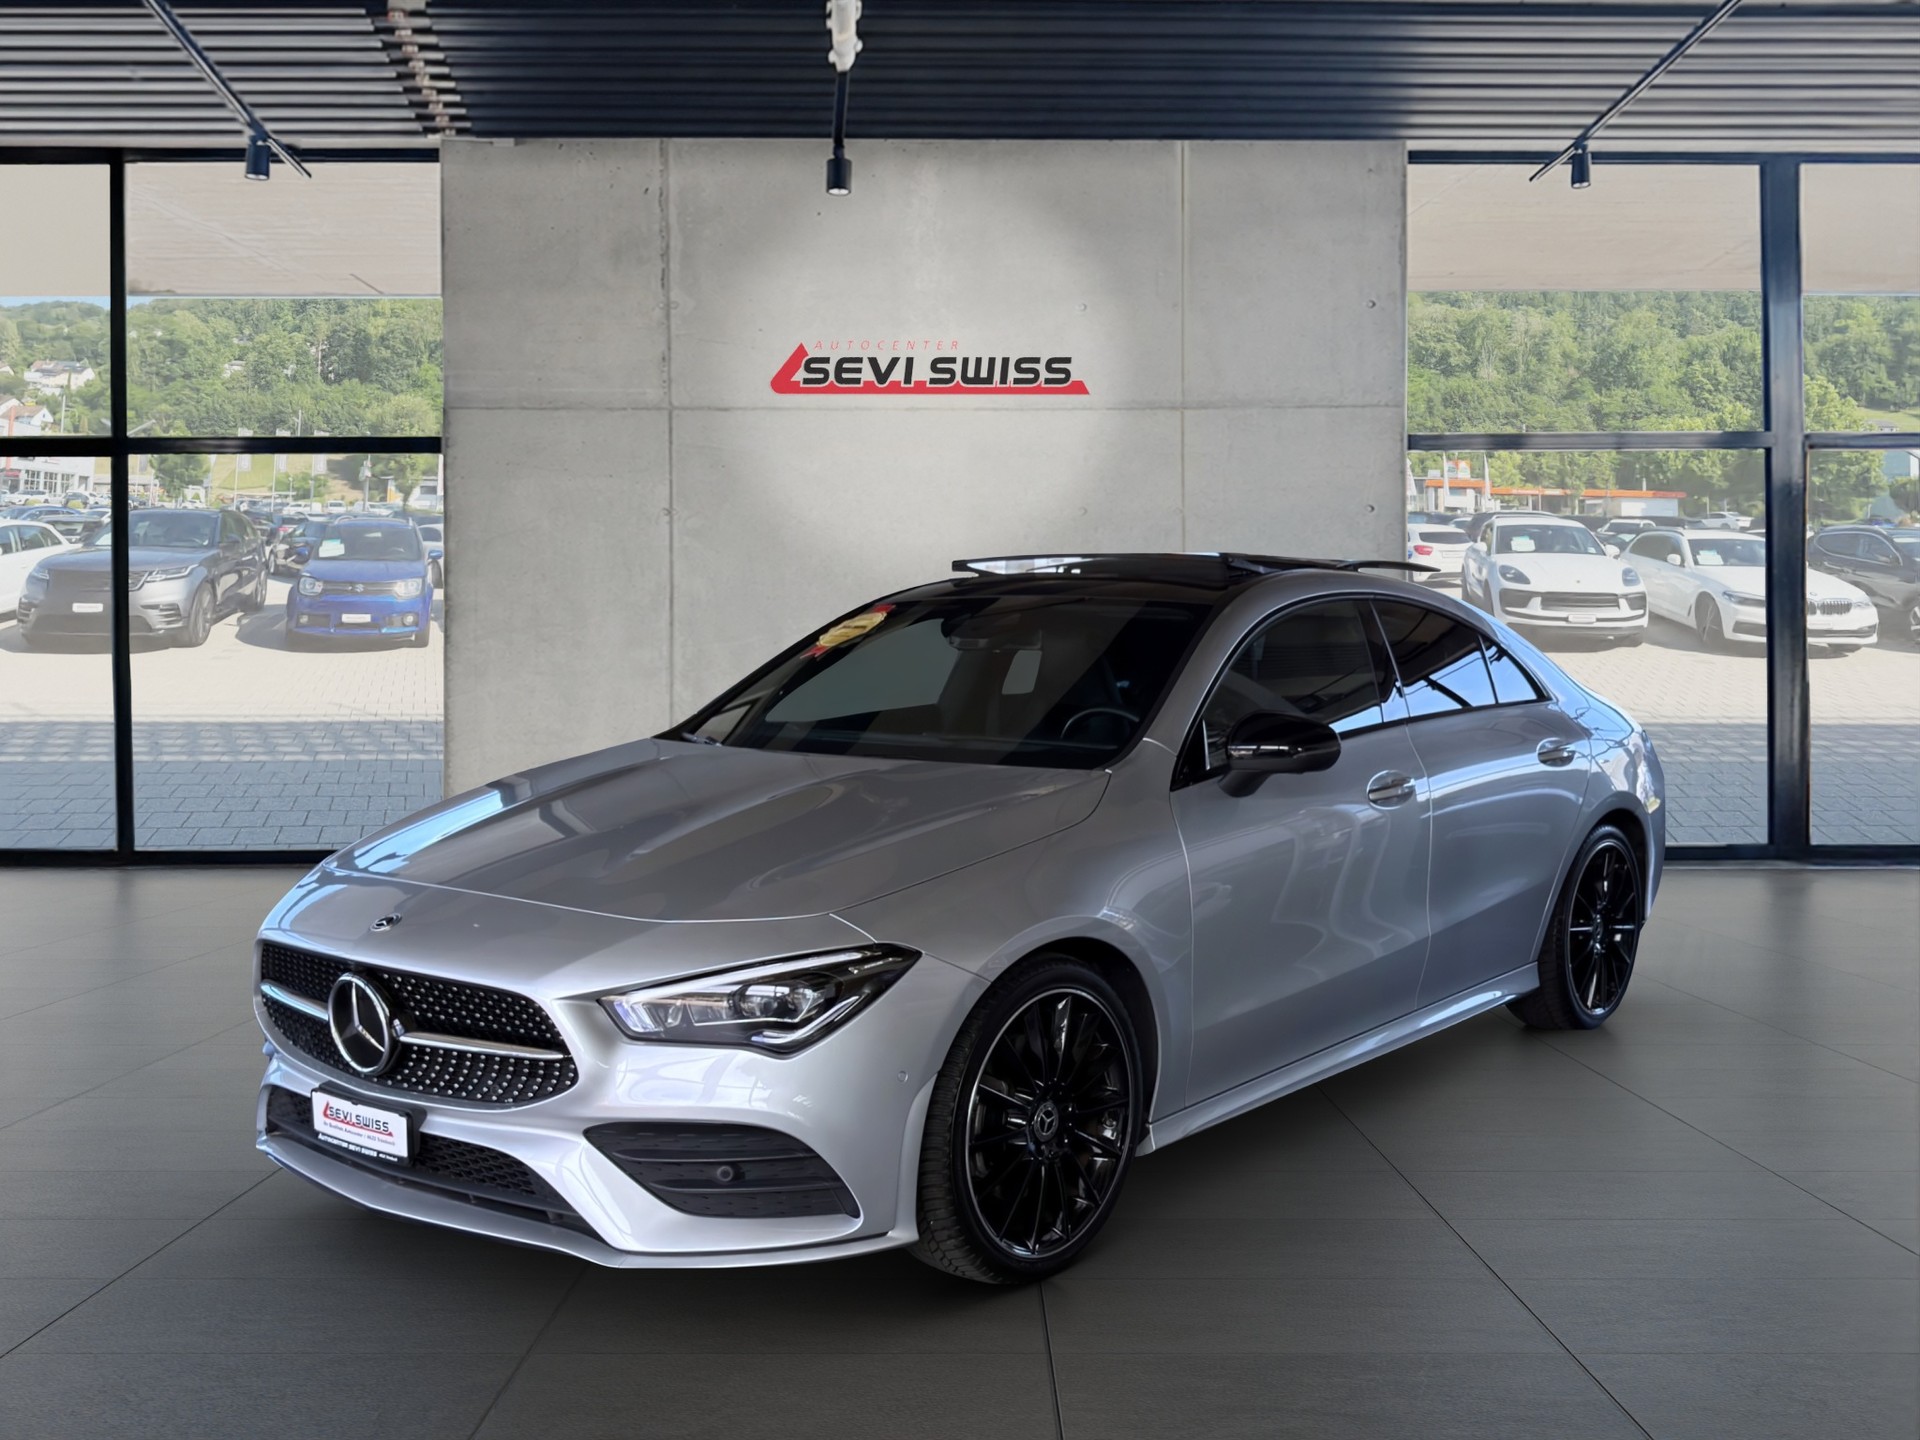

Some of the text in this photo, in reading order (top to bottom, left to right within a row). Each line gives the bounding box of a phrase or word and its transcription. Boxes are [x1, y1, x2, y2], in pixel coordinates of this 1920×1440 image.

[814, 340, 959, 350] AUTOCENTER
[801, 356, 1073, 385] SEVI SWISS
[329, 1106, 389, 1132] SEVI SWISS
